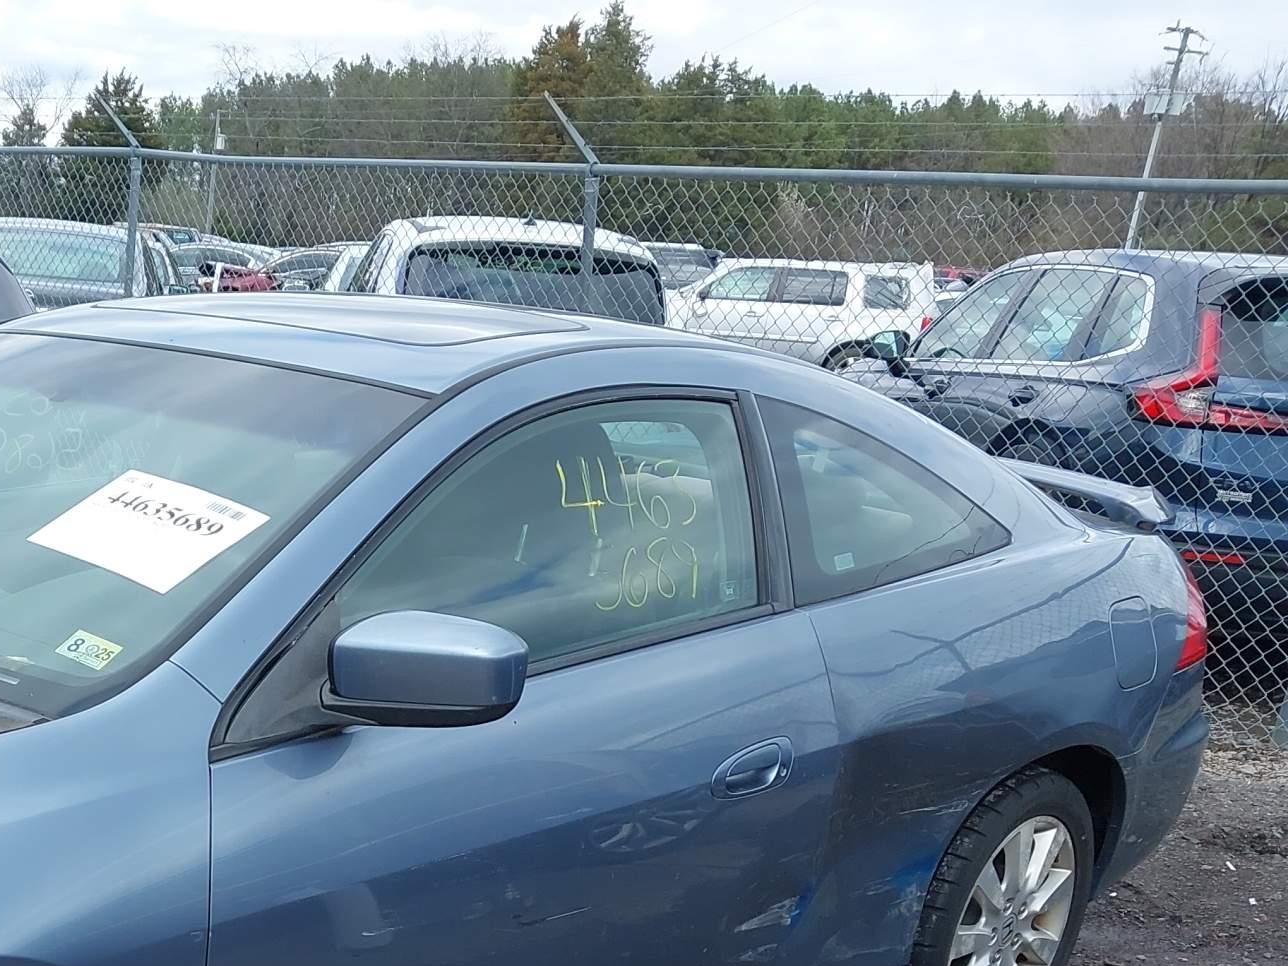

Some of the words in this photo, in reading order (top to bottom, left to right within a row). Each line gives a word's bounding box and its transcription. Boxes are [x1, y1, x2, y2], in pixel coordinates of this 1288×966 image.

[107, 491, 224, 536] 44635689
[555, 455, 697, 537] 4463
[66, 638, 86, 652] 8
[94, 647, 116, 661] 25
